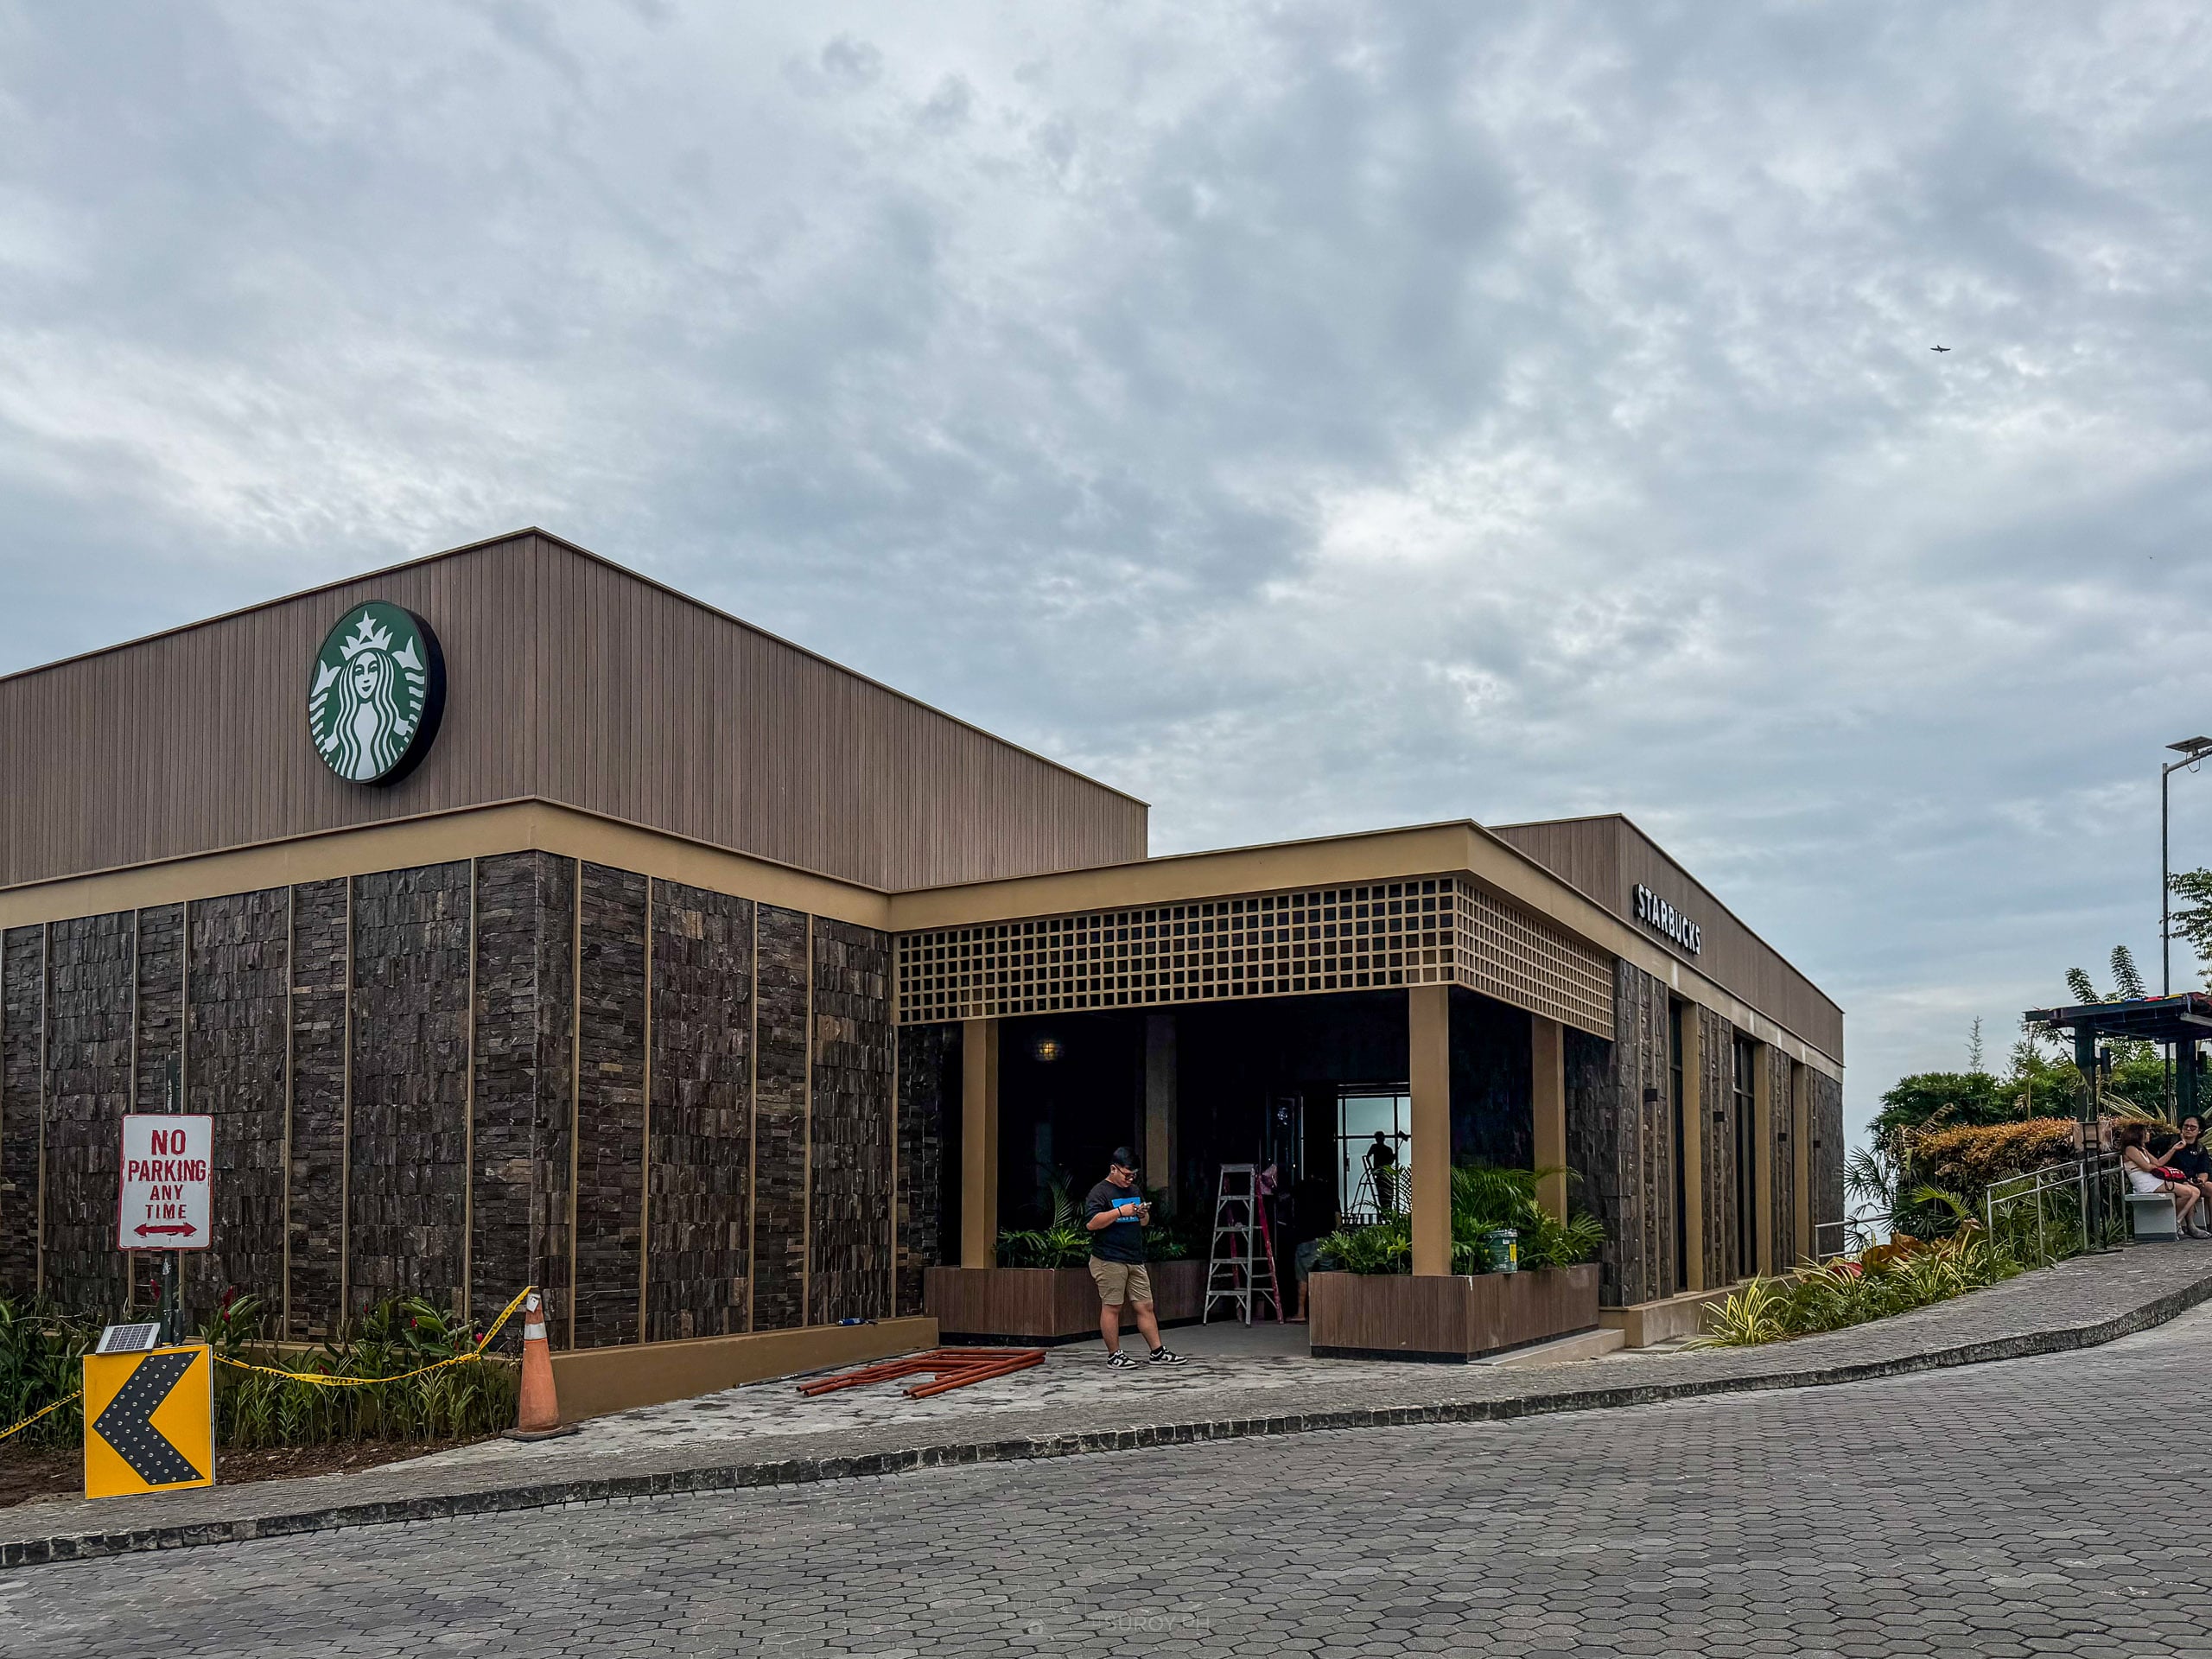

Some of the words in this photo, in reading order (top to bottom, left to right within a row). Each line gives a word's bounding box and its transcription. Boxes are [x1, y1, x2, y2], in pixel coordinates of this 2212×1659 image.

[1635, 882, 1701, 955] STARBUCKS
[151, 1128, 187, 1156] NO
[128, 1159, 207, 1183] PARKING
[149, 1184, 184, 1201] ANY
[145, 1204, 188, 1219] TIME
